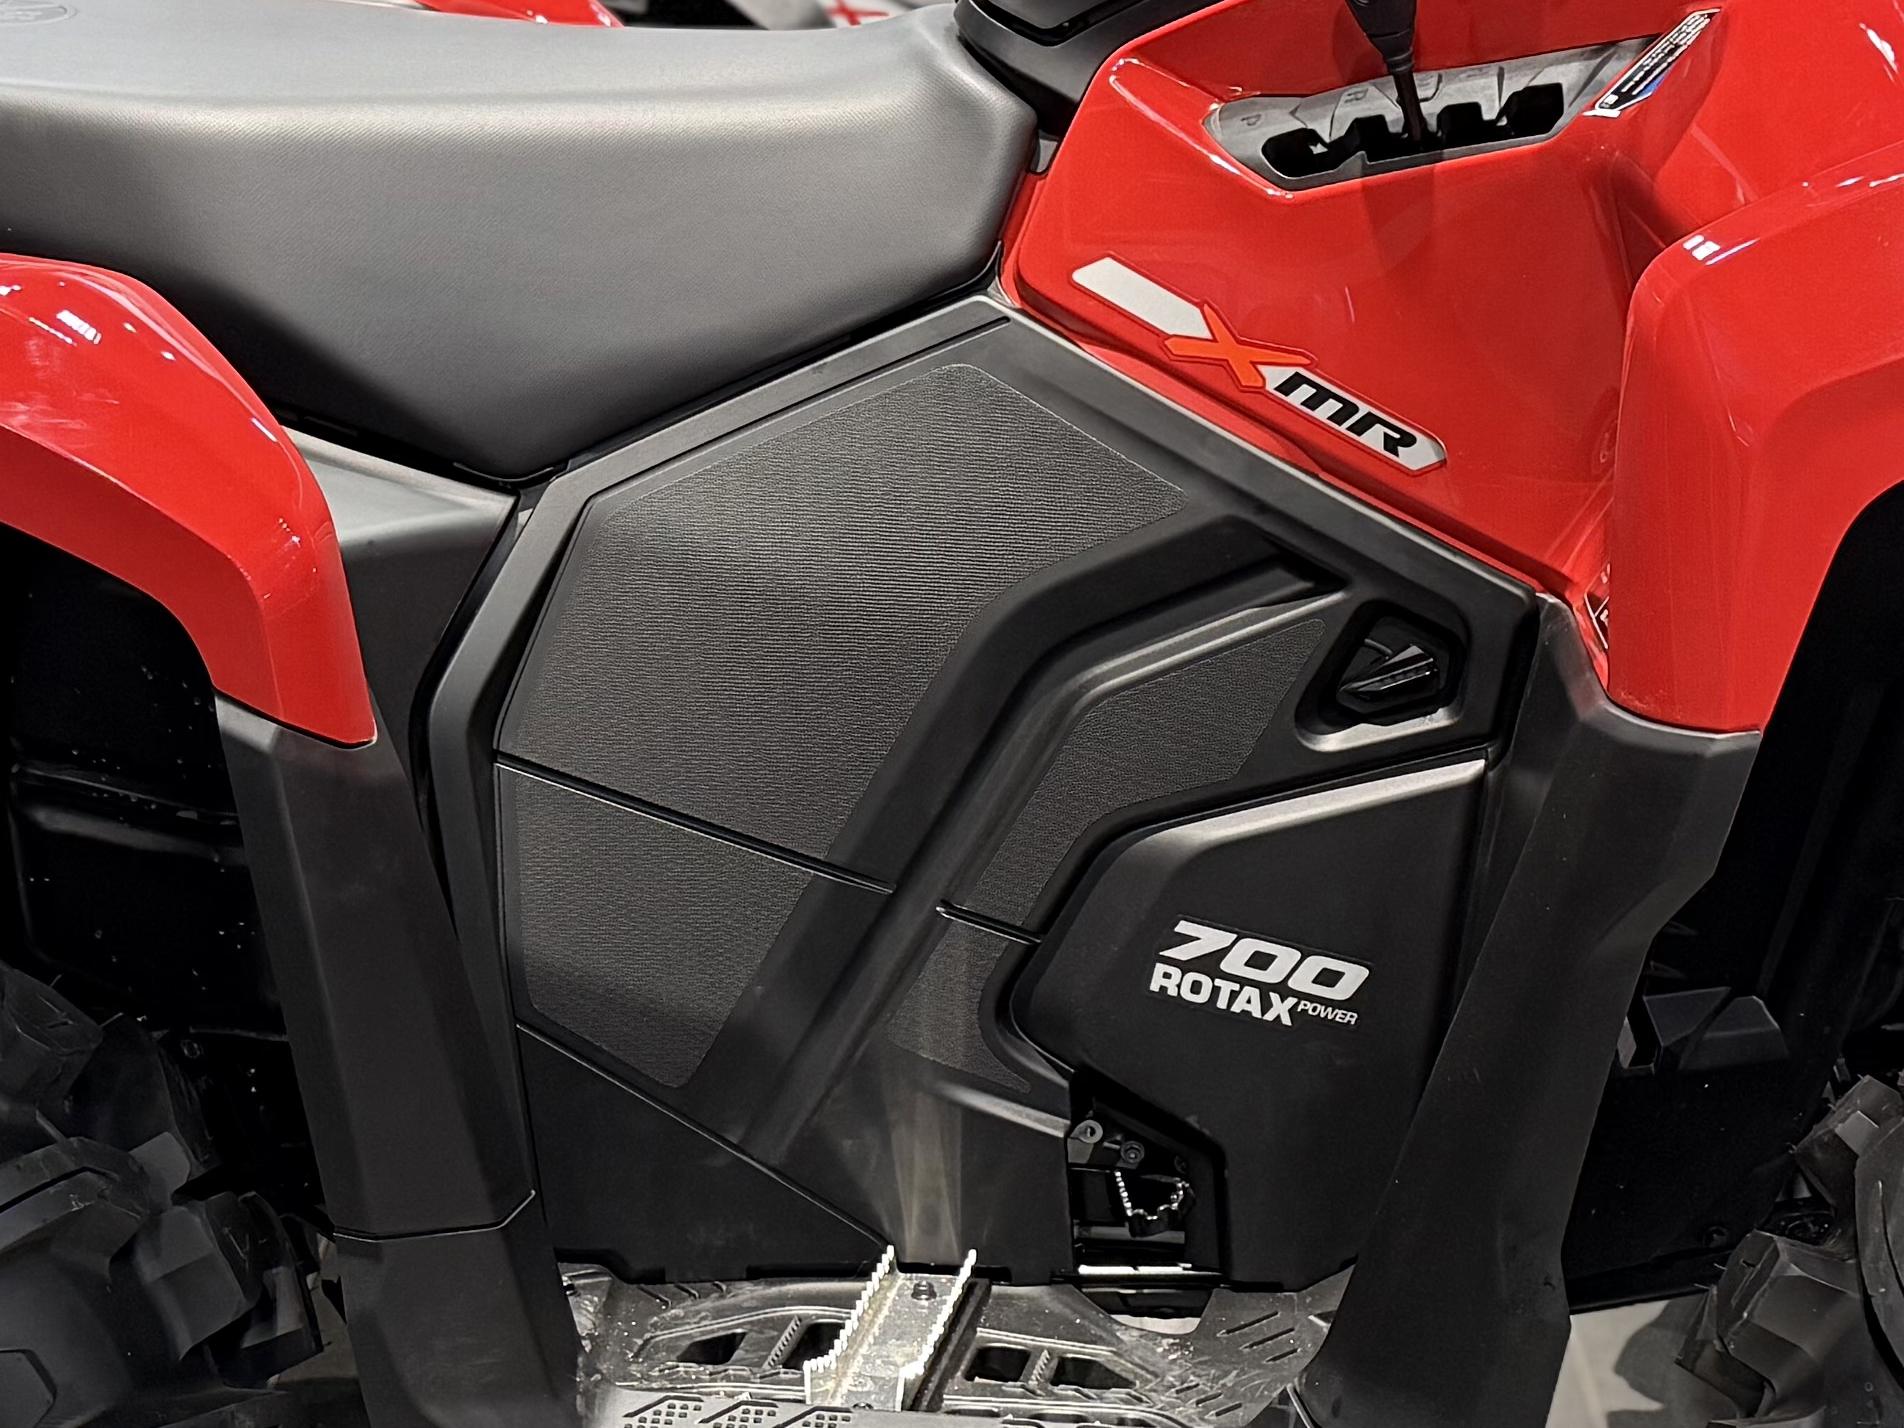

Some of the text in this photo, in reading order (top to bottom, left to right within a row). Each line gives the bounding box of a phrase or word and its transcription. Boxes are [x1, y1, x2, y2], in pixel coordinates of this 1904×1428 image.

[1149, 962, 1359, 1027] ROTAX POWER
[1158, 919, 1370, 1002] 700
